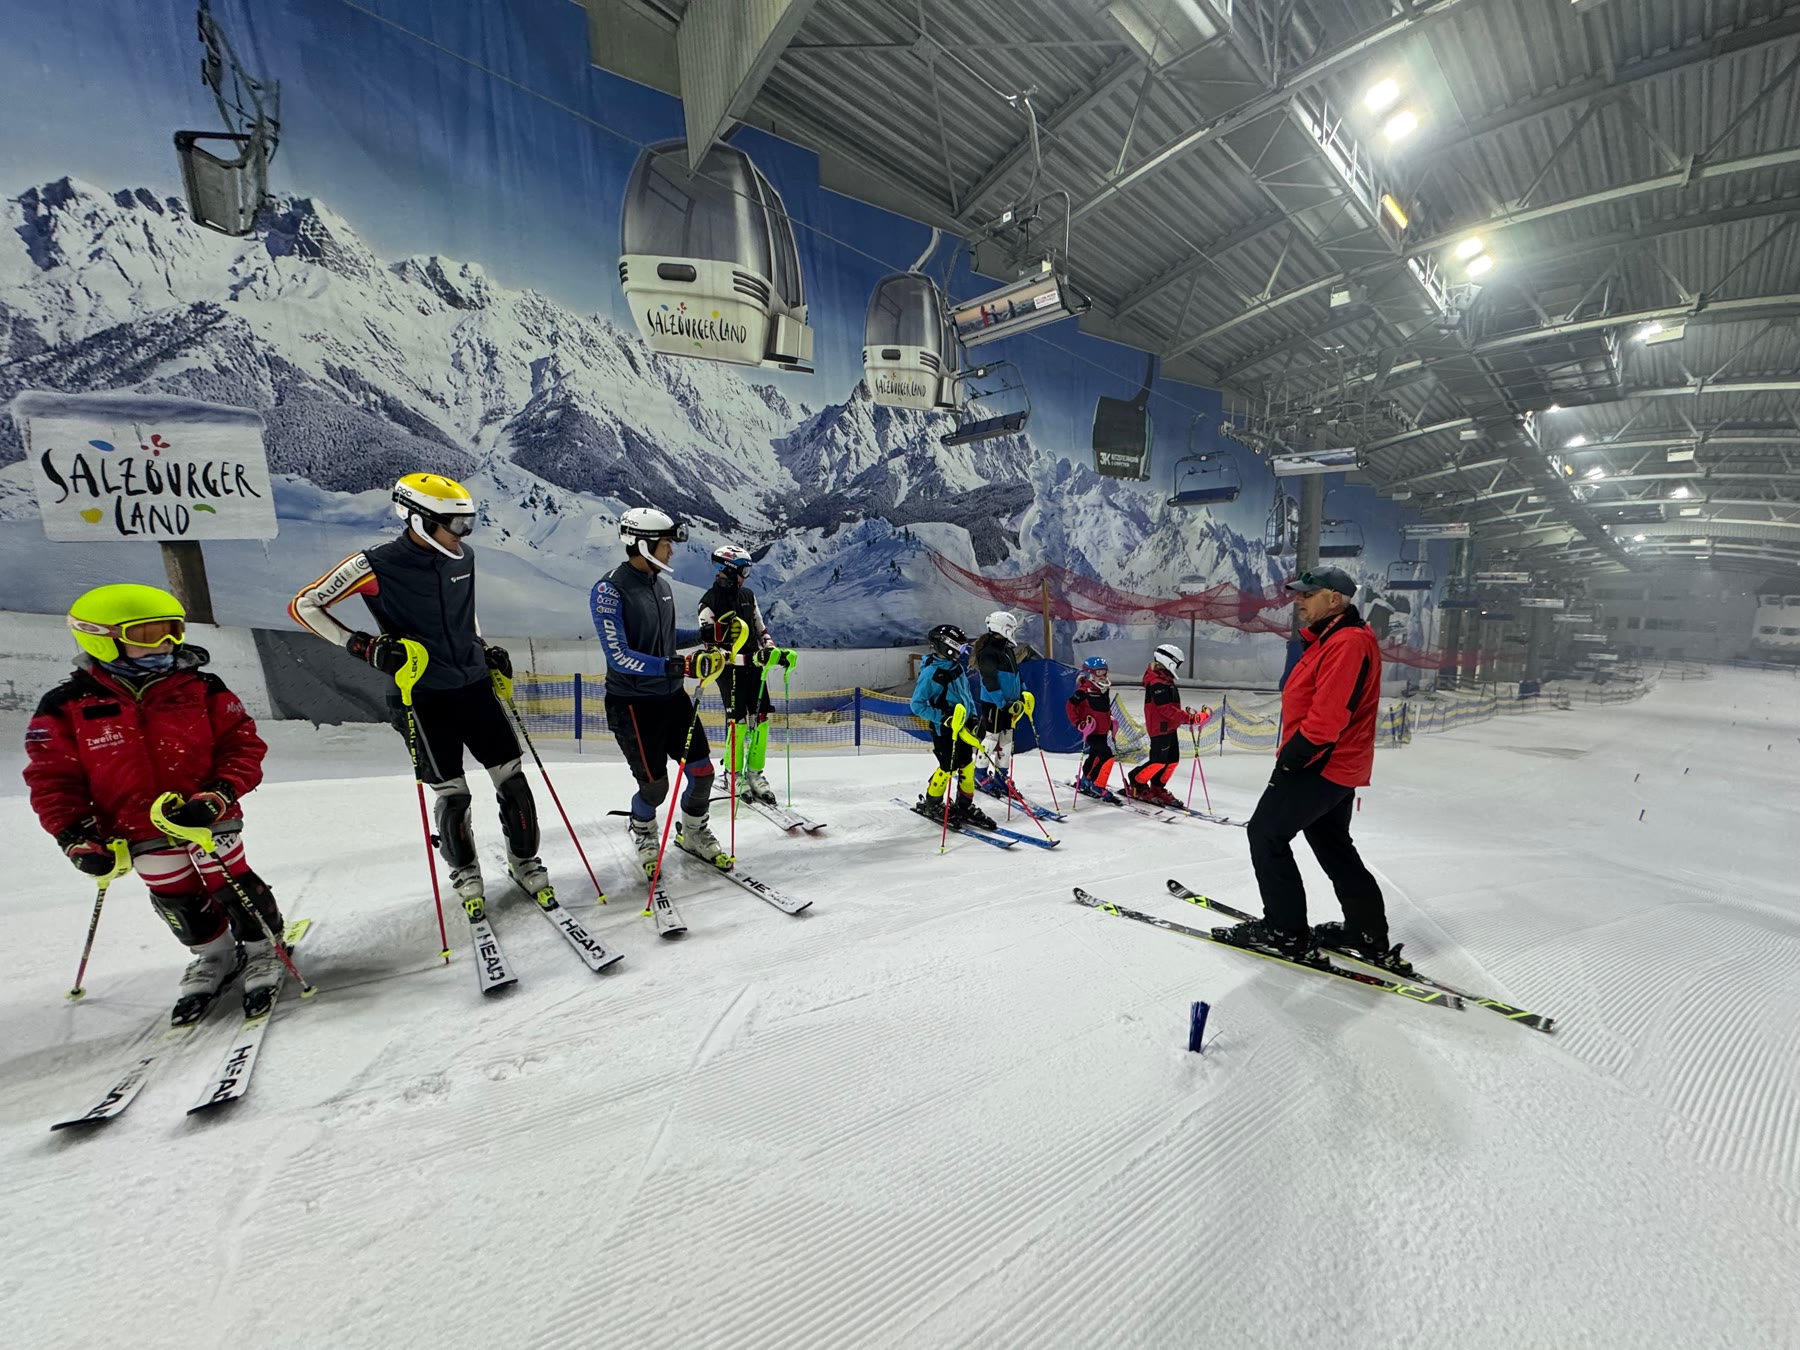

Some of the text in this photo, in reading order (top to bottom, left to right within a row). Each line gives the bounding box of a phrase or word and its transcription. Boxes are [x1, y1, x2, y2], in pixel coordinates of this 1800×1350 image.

[41, 448, 261, 503] SALZBURGER
[115, 496, 190, 535] LAND
[317, 572, 348, 602] Audi
[603, 619, 646, 673] THAILAND
[410, 656, 418, 679] LEKI
[85, 731, 123, 746] Zweifel
[407, 711, 417, 740] LEKI
[476, 933, 506, 982] HEAD
[560, 918, 606, 960] HEAD
